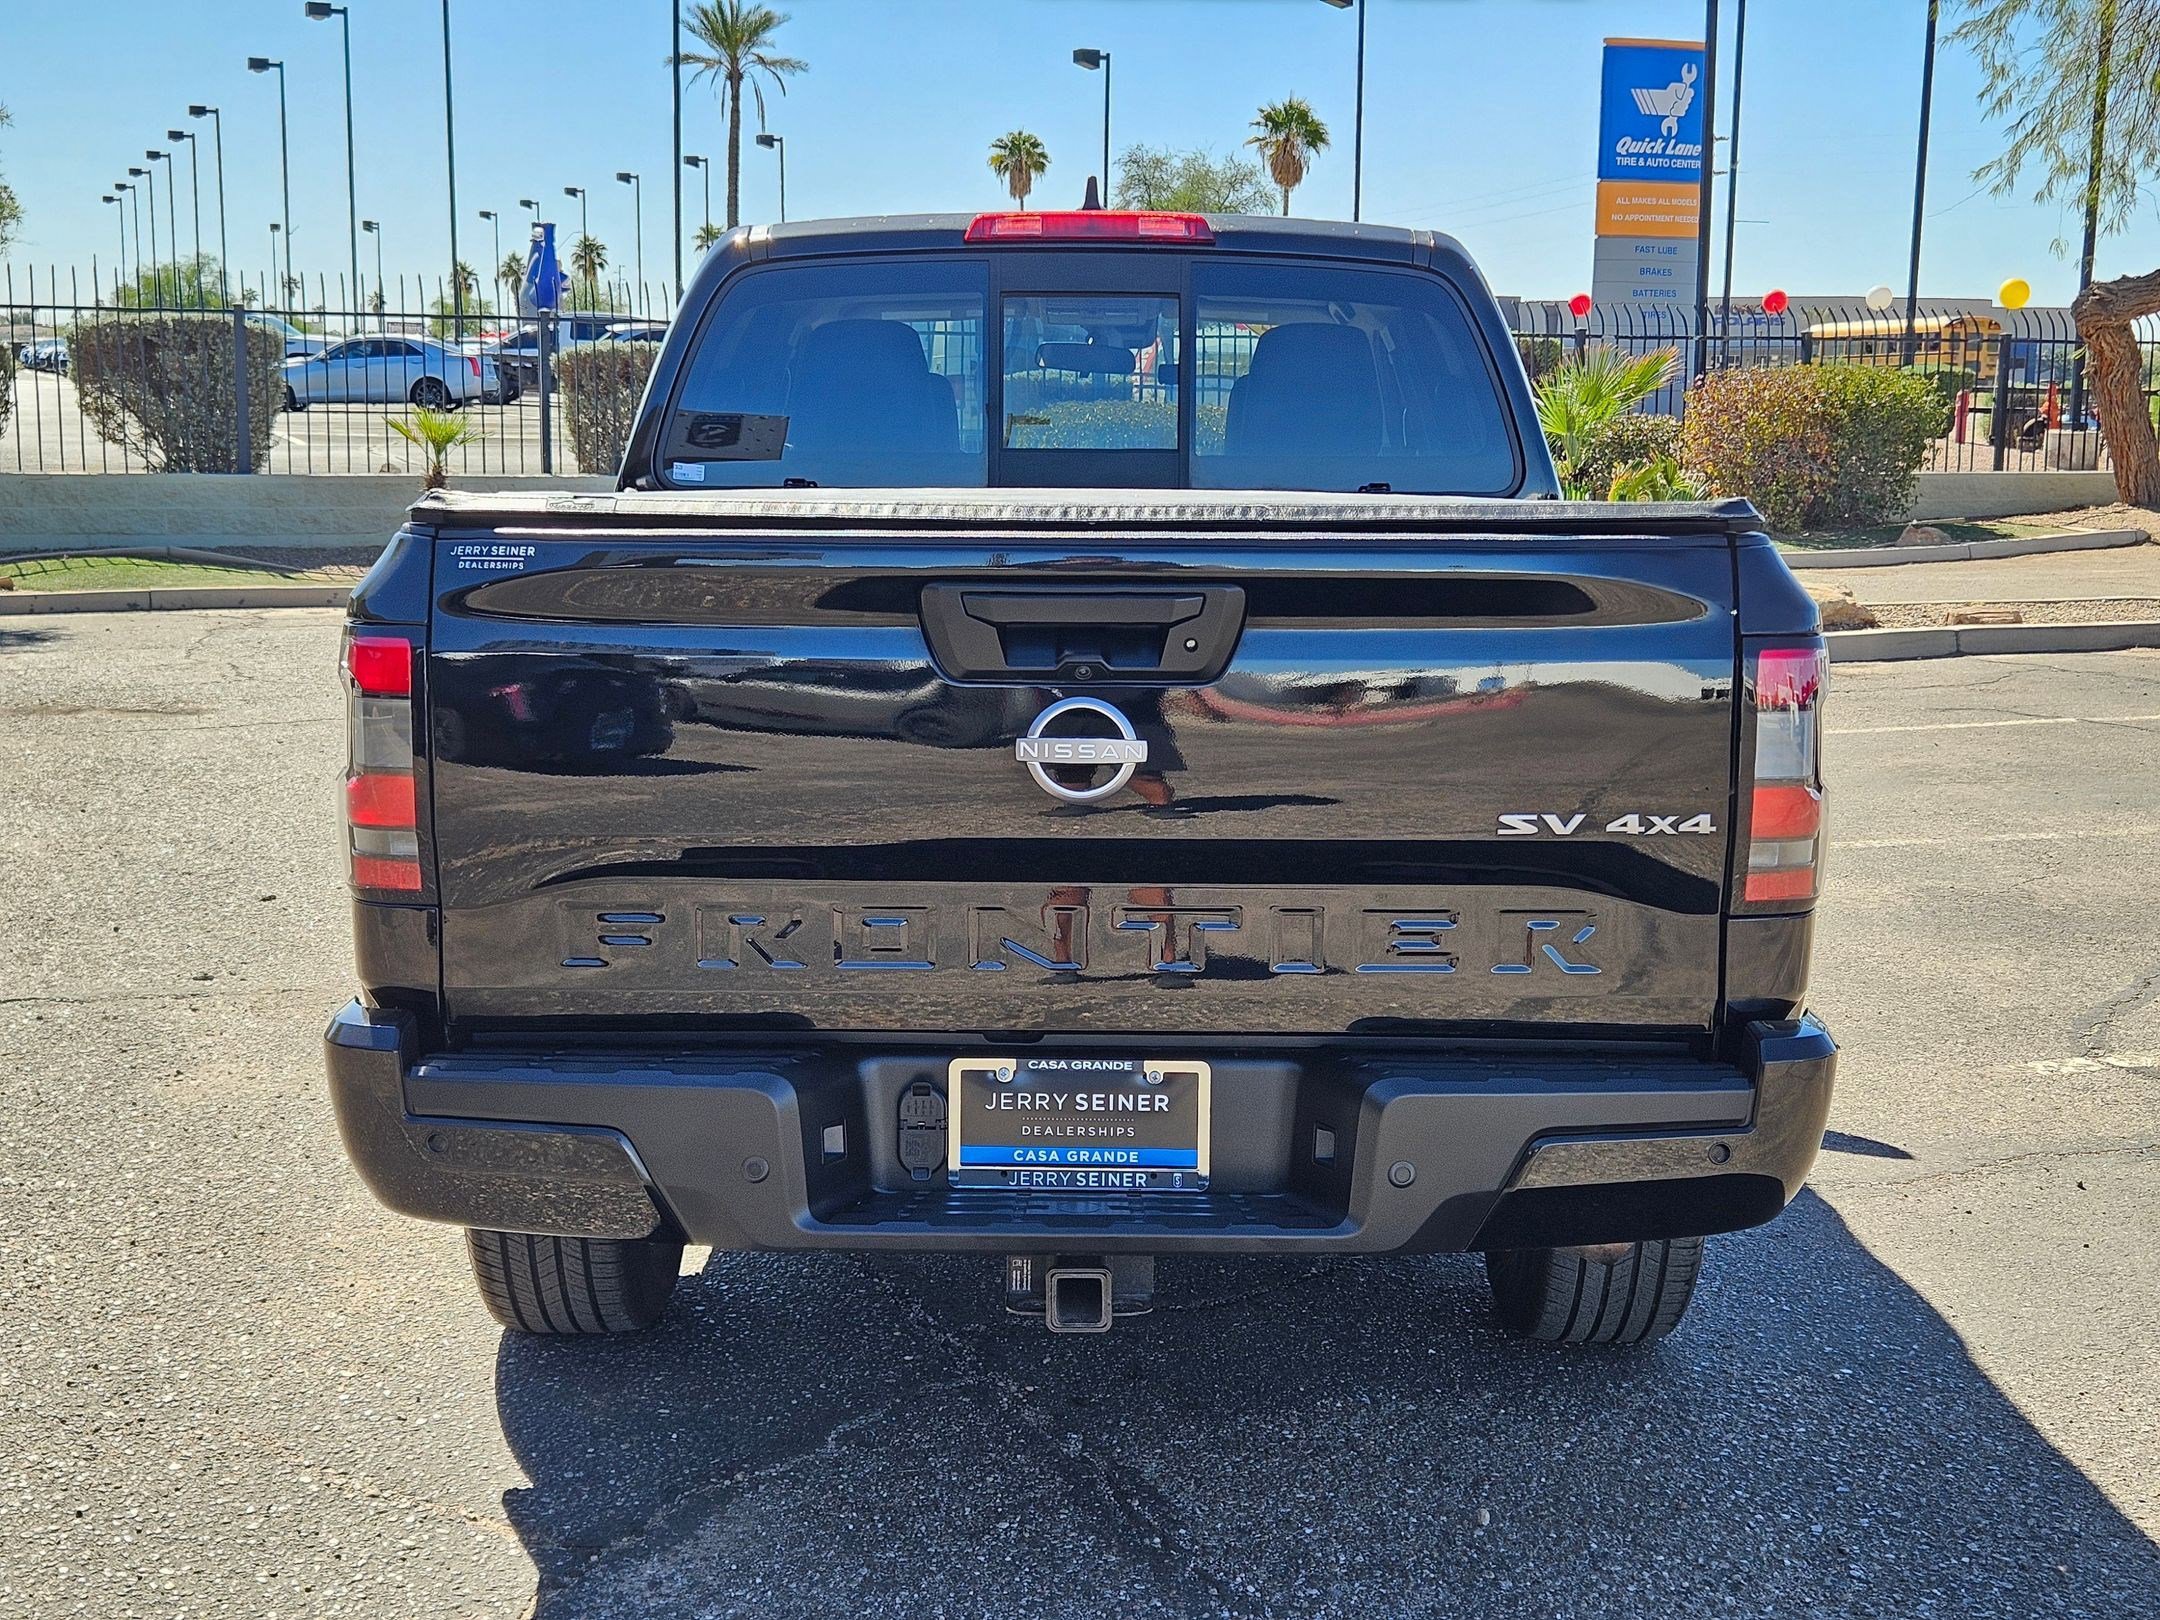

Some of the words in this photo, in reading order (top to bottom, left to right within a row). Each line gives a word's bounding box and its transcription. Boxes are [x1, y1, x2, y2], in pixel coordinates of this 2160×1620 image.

[1616, 136, 1665, 155] Quick
[1665, 139, 1702, 156] Lane
[1616, 157, 1637, 166] TIRE
[1638, 157, 1645, 166] &
[1646, 158, 1670, 168] AUTO
[1671, 159, 1701, 169] CENTER
[1616, 197, 1631, 205] ALL
[1632, 197, 1657, 206] MAKES
[1658, 198, 1671, 206] ALL
[1672, 199, 1697, 207] MODELS
[1611, 213, 1624, 221] NO
[1625, 214, 1674, 223] APPOINTMENT
[1675, 215, 1699, 224] NEEDED
[1635, 246, 1655, 254] FAST
[1657, 247, 1678, 255] LUBE
[1640, 267, 1673, 277] BRAKES
[1632, 289, 1677, 298] BATTERIES
[1643, 311, 1667, 319] TIRES
[450, 546, 490, 556] JERRY
[491, 546, 536, 557] SEINER
[458, 561, 524, 570] DEALERSHIPS
[1019, 741, 1143, 760] NISSAN
[1497, 813, 1587, 835] SV
[1605, 813, 1717, 835] 4x4
[560, 903, 1602, 976] FRONTIER
[1028, 1060, 1069, 1070] CASA
[1071, 1061, 1134, 1071] GRANDE
[985, 1092, 1068, 1111] JERRY
[1075, 1093, 1170, 1112] SEINER
[1021, 1125, 1136, 1137] DEALERSHIPS
[1013, 1149, 1057, 1162] CASA
[1067, 1150, 1140, 1163] GRANDE
[1008, 1171, 1072, 1186] JERRY
[1076, 1172, 1148, 1188] SEINER
